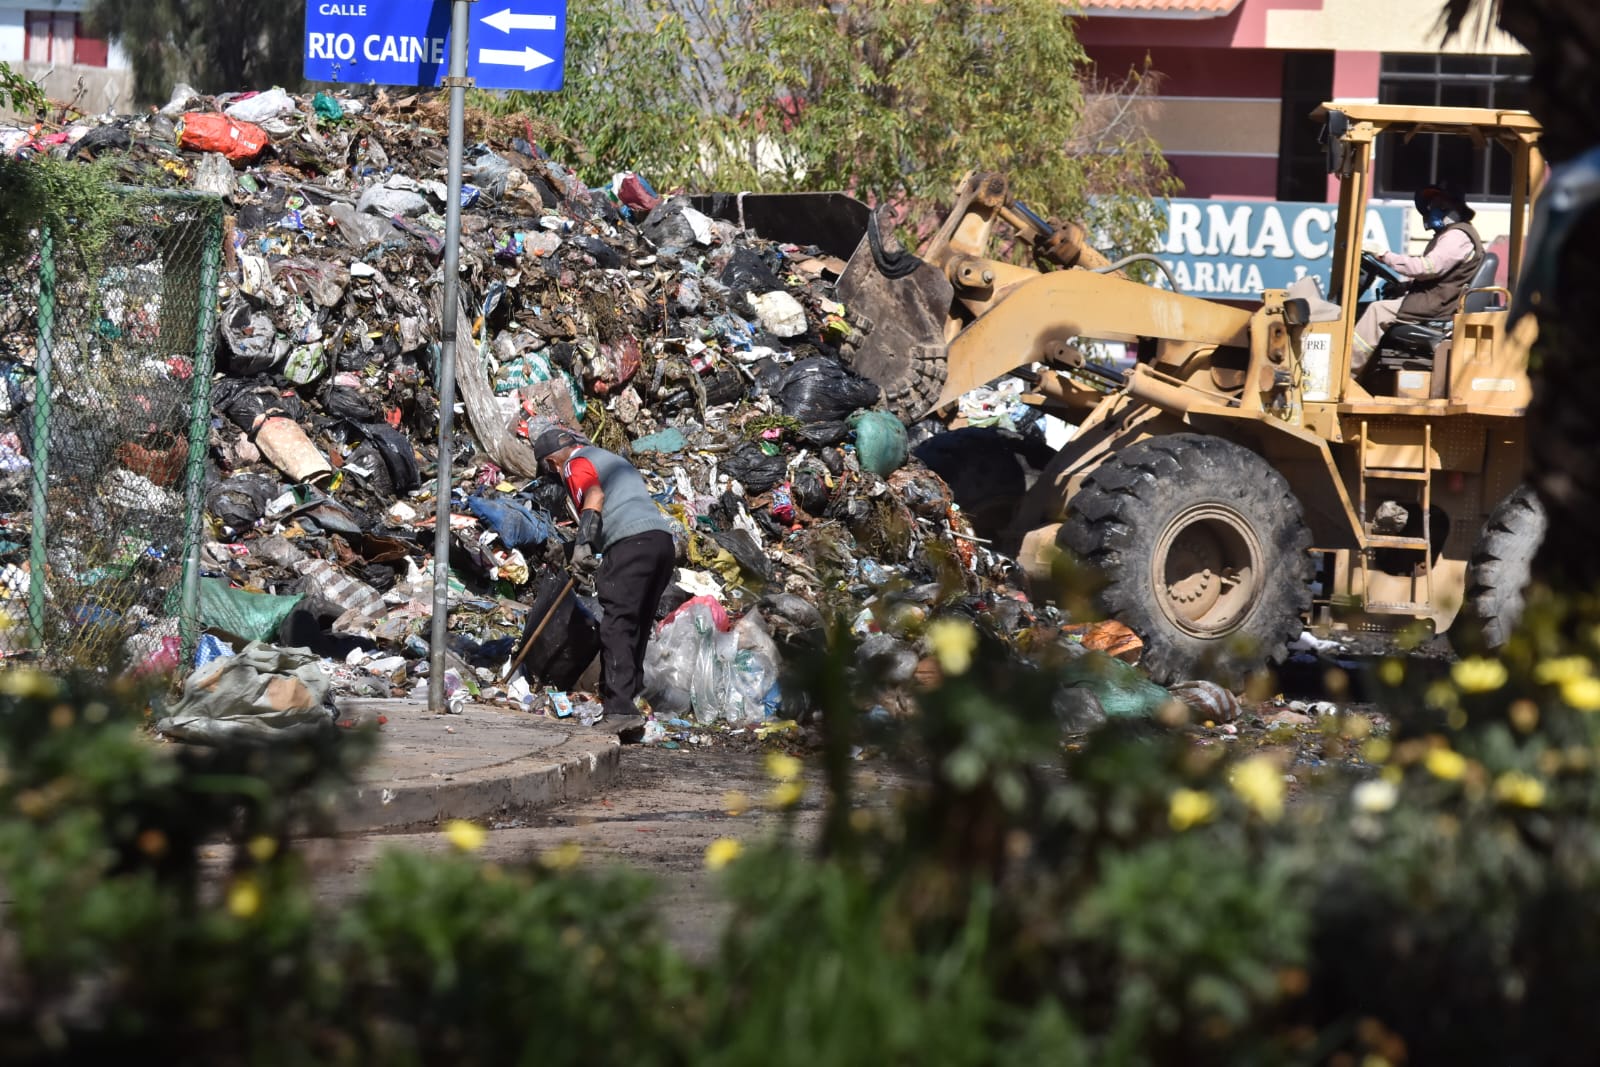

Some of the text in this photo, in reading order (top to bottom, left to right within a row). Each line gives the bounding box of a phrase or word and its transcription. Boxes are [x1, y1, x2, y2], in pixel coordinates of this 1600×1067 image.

[319, 4, 367, 16] CALLE
[309, 32, 445, 64] RIO CAINE
[1096, 200, 1392, 260] RMACA
